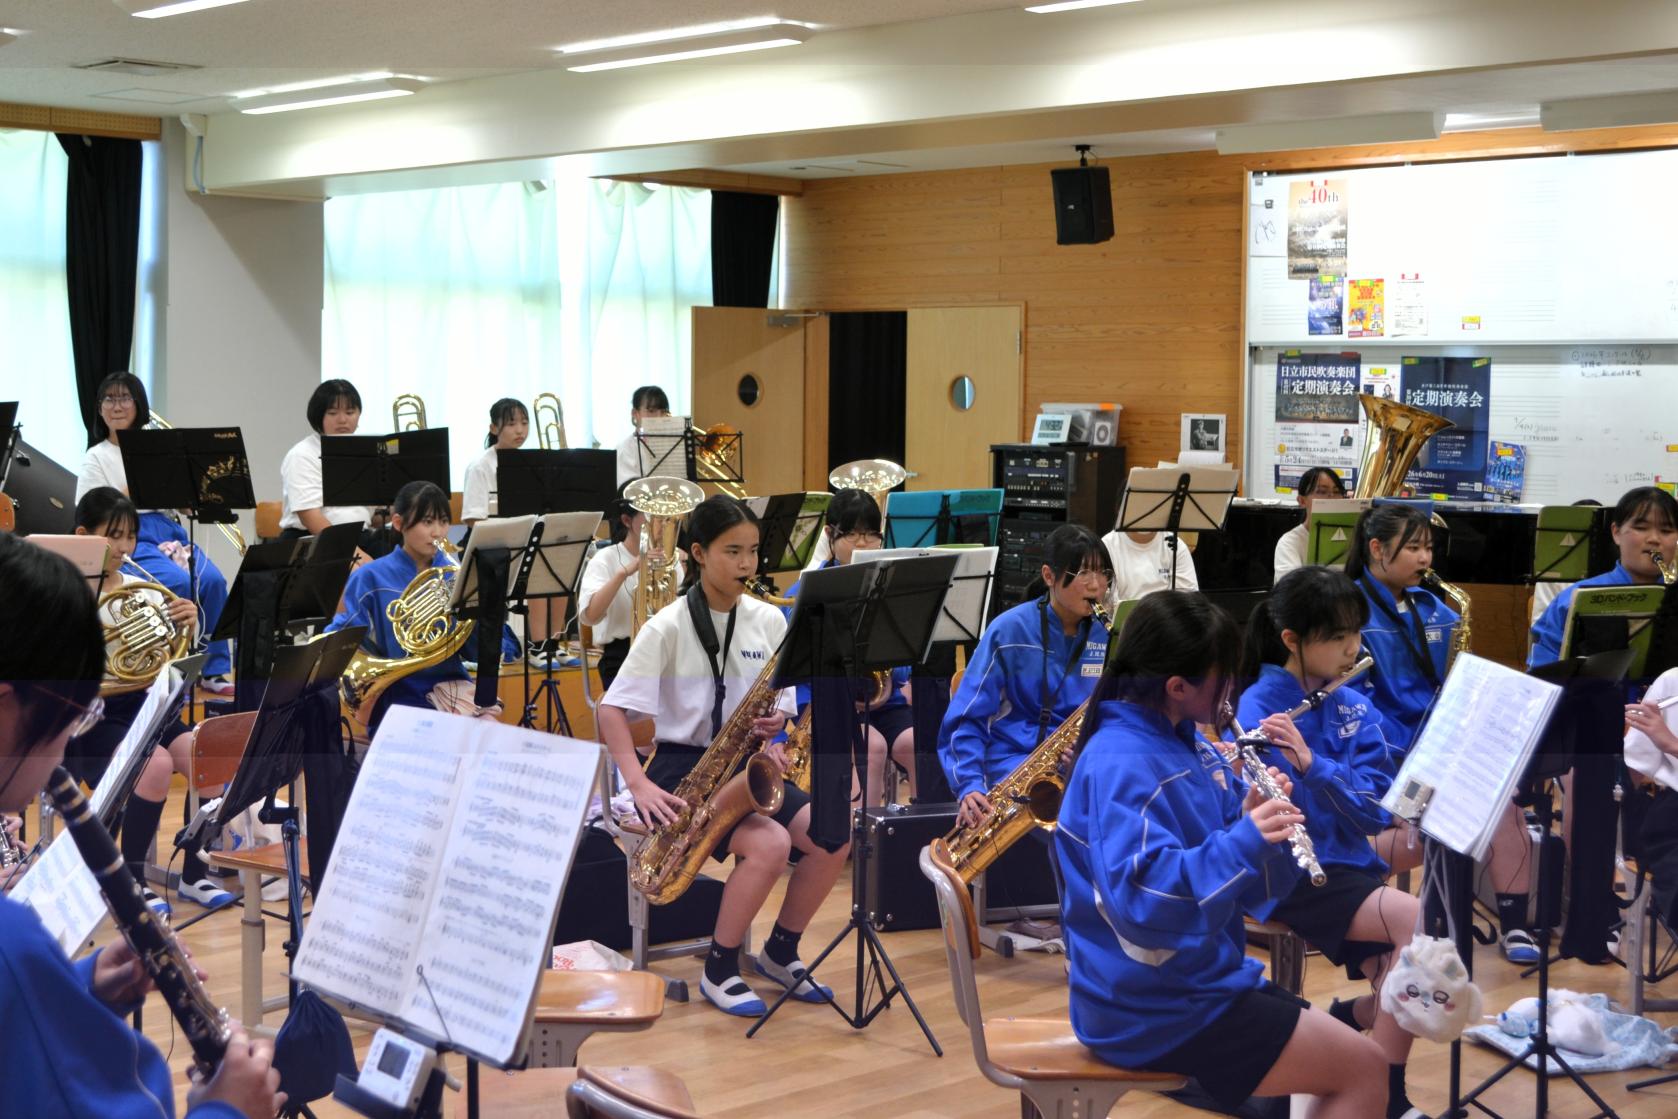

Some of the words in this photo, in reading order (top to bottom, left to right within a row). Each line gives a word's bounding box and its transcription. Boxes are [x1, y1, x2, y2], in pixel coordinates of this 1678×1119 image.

[1308, 188, 1339, 204] 40th
[1281, 365, 1356, 378] 日立市民吹奏楽団
[1292, 380, 1355, 395] 定期演奏会
[1412, 390, 1484, 407] 定期演奏会
